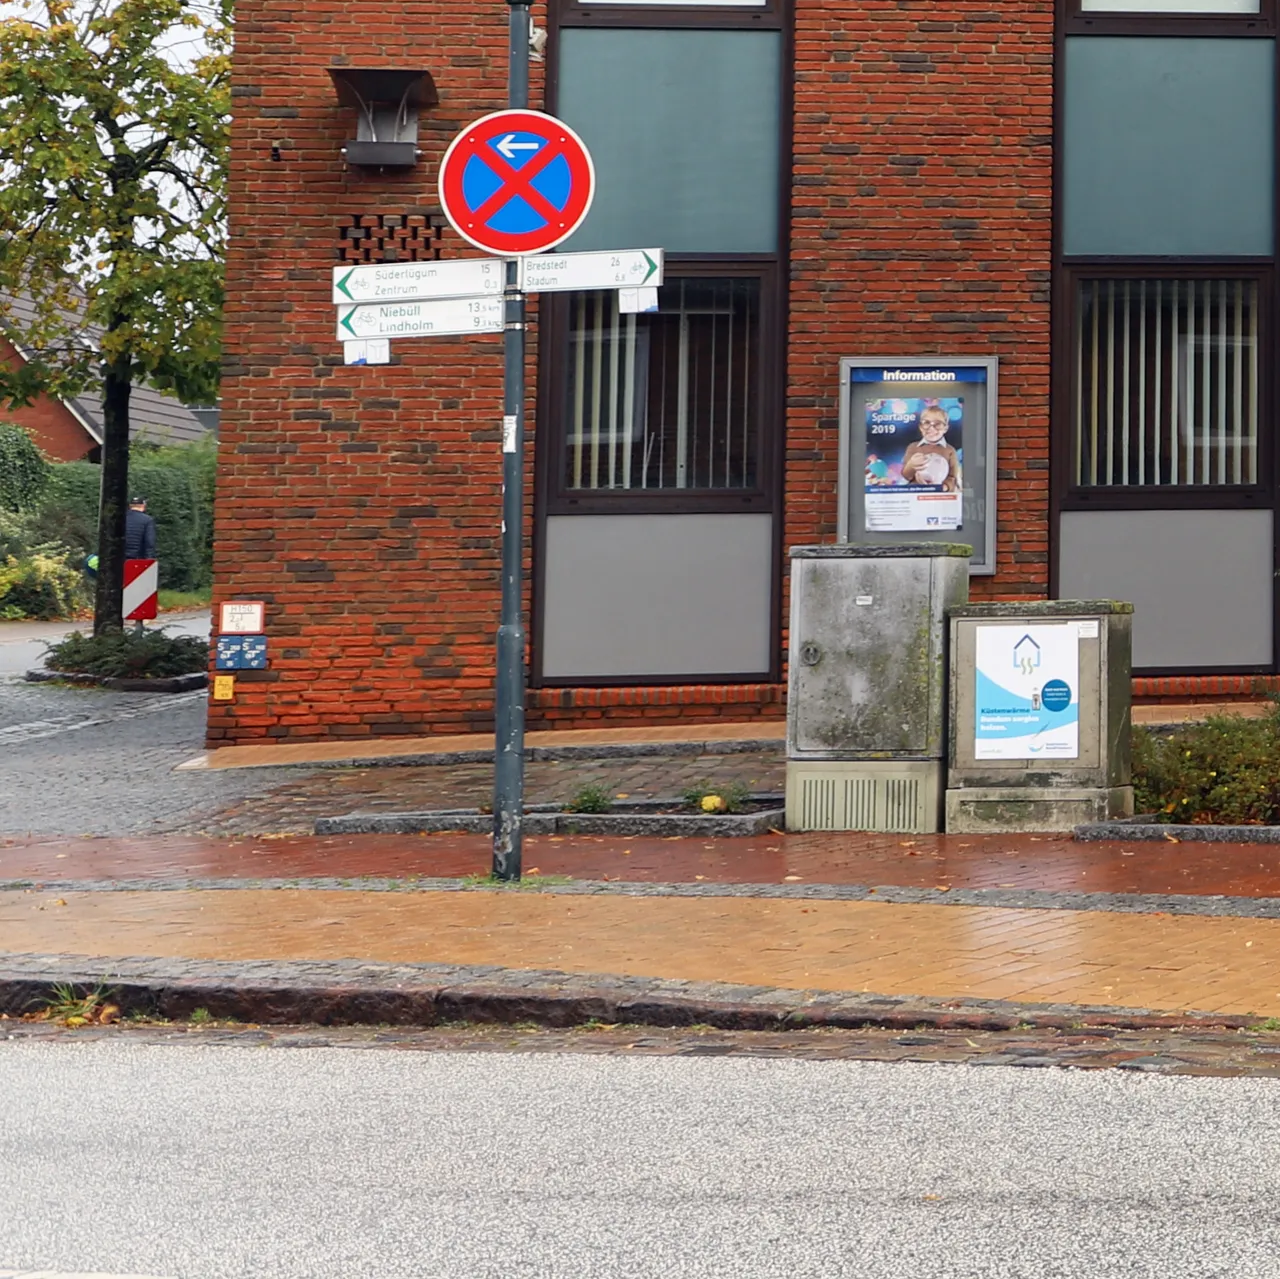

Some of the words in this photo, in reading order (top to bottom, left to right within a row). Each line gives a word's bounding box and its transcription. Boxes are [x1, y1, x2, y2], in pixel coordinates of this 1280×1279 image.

[526, 261, 568, 271] Bredstedt
[611, 257, 621, 267] 26
[375, 268, 438, 281] Süderlügum
[481, 264, 491, 274] 15
[526, 276, 558, 286] Stadum
[375, 285, 418, 296] Zentrum
[379, 305, 421, 317] Niebüll
[379, 321, 434, 332] Lindholm
[883, 370, 956, 381] Information
[871, 412, 916, 423] Spartage
[871, 425, 896, 434] 2019
